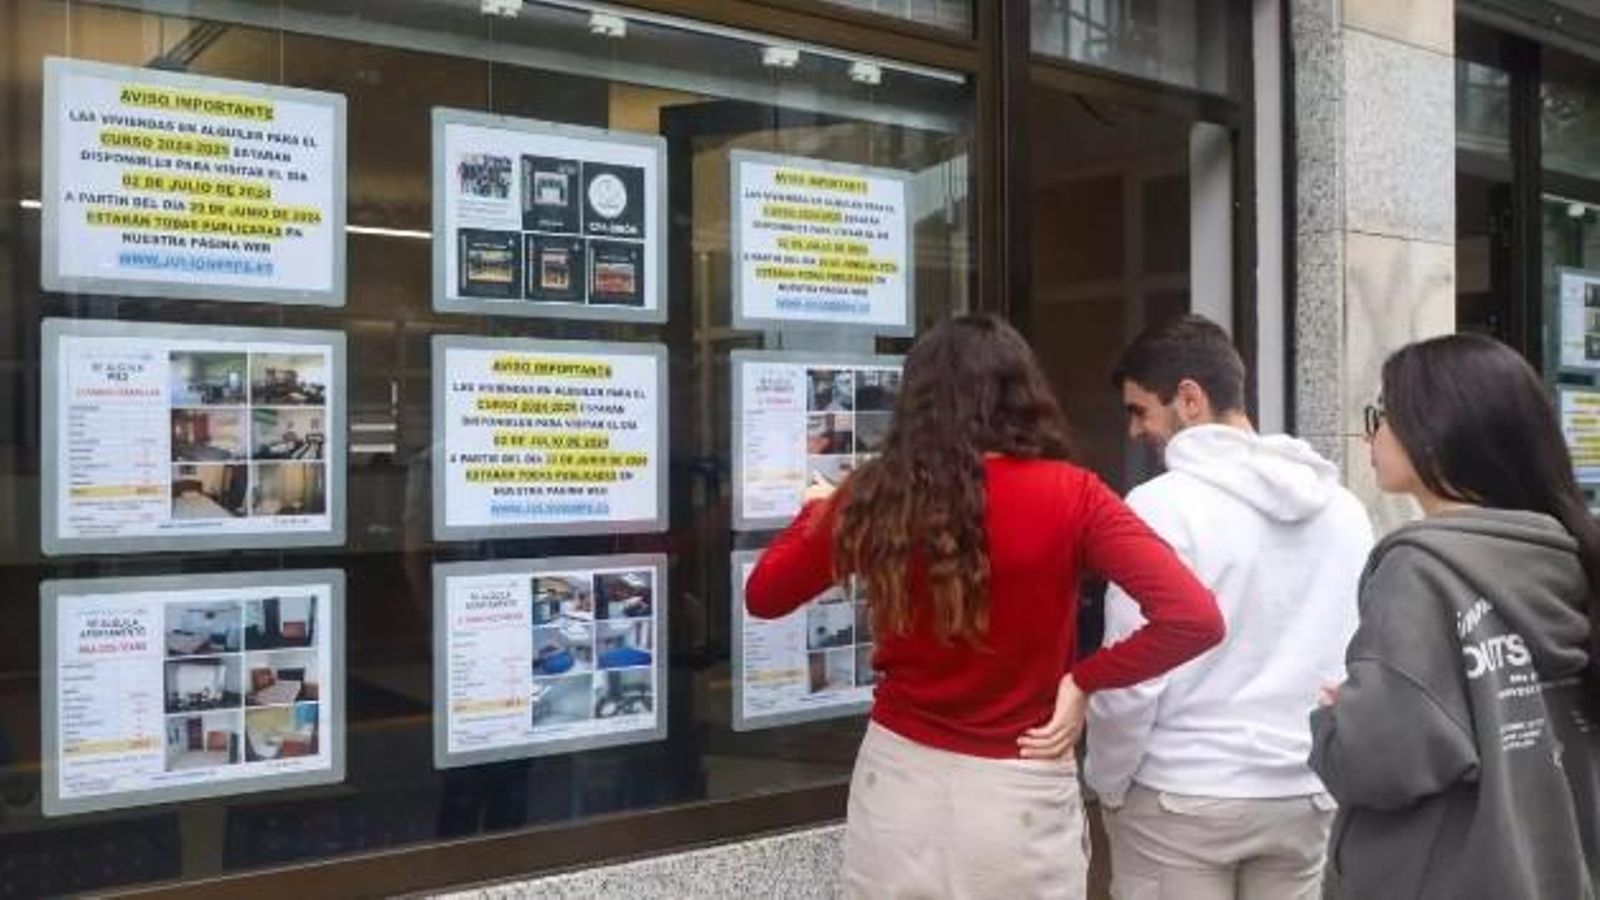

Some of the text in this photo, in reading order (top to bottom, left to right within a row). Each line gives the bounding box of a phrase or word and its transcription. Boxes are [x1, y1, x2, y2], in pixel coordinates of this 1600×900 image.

[120, 89, 274, 119] AVISO IMPORTANTE
[101, 115, 175, 131] VIVIENDAS
[100, 133, 153, 148] CURSO
[169, 179, 212, 194] JULIO
[64, 190, 75, 202] A
